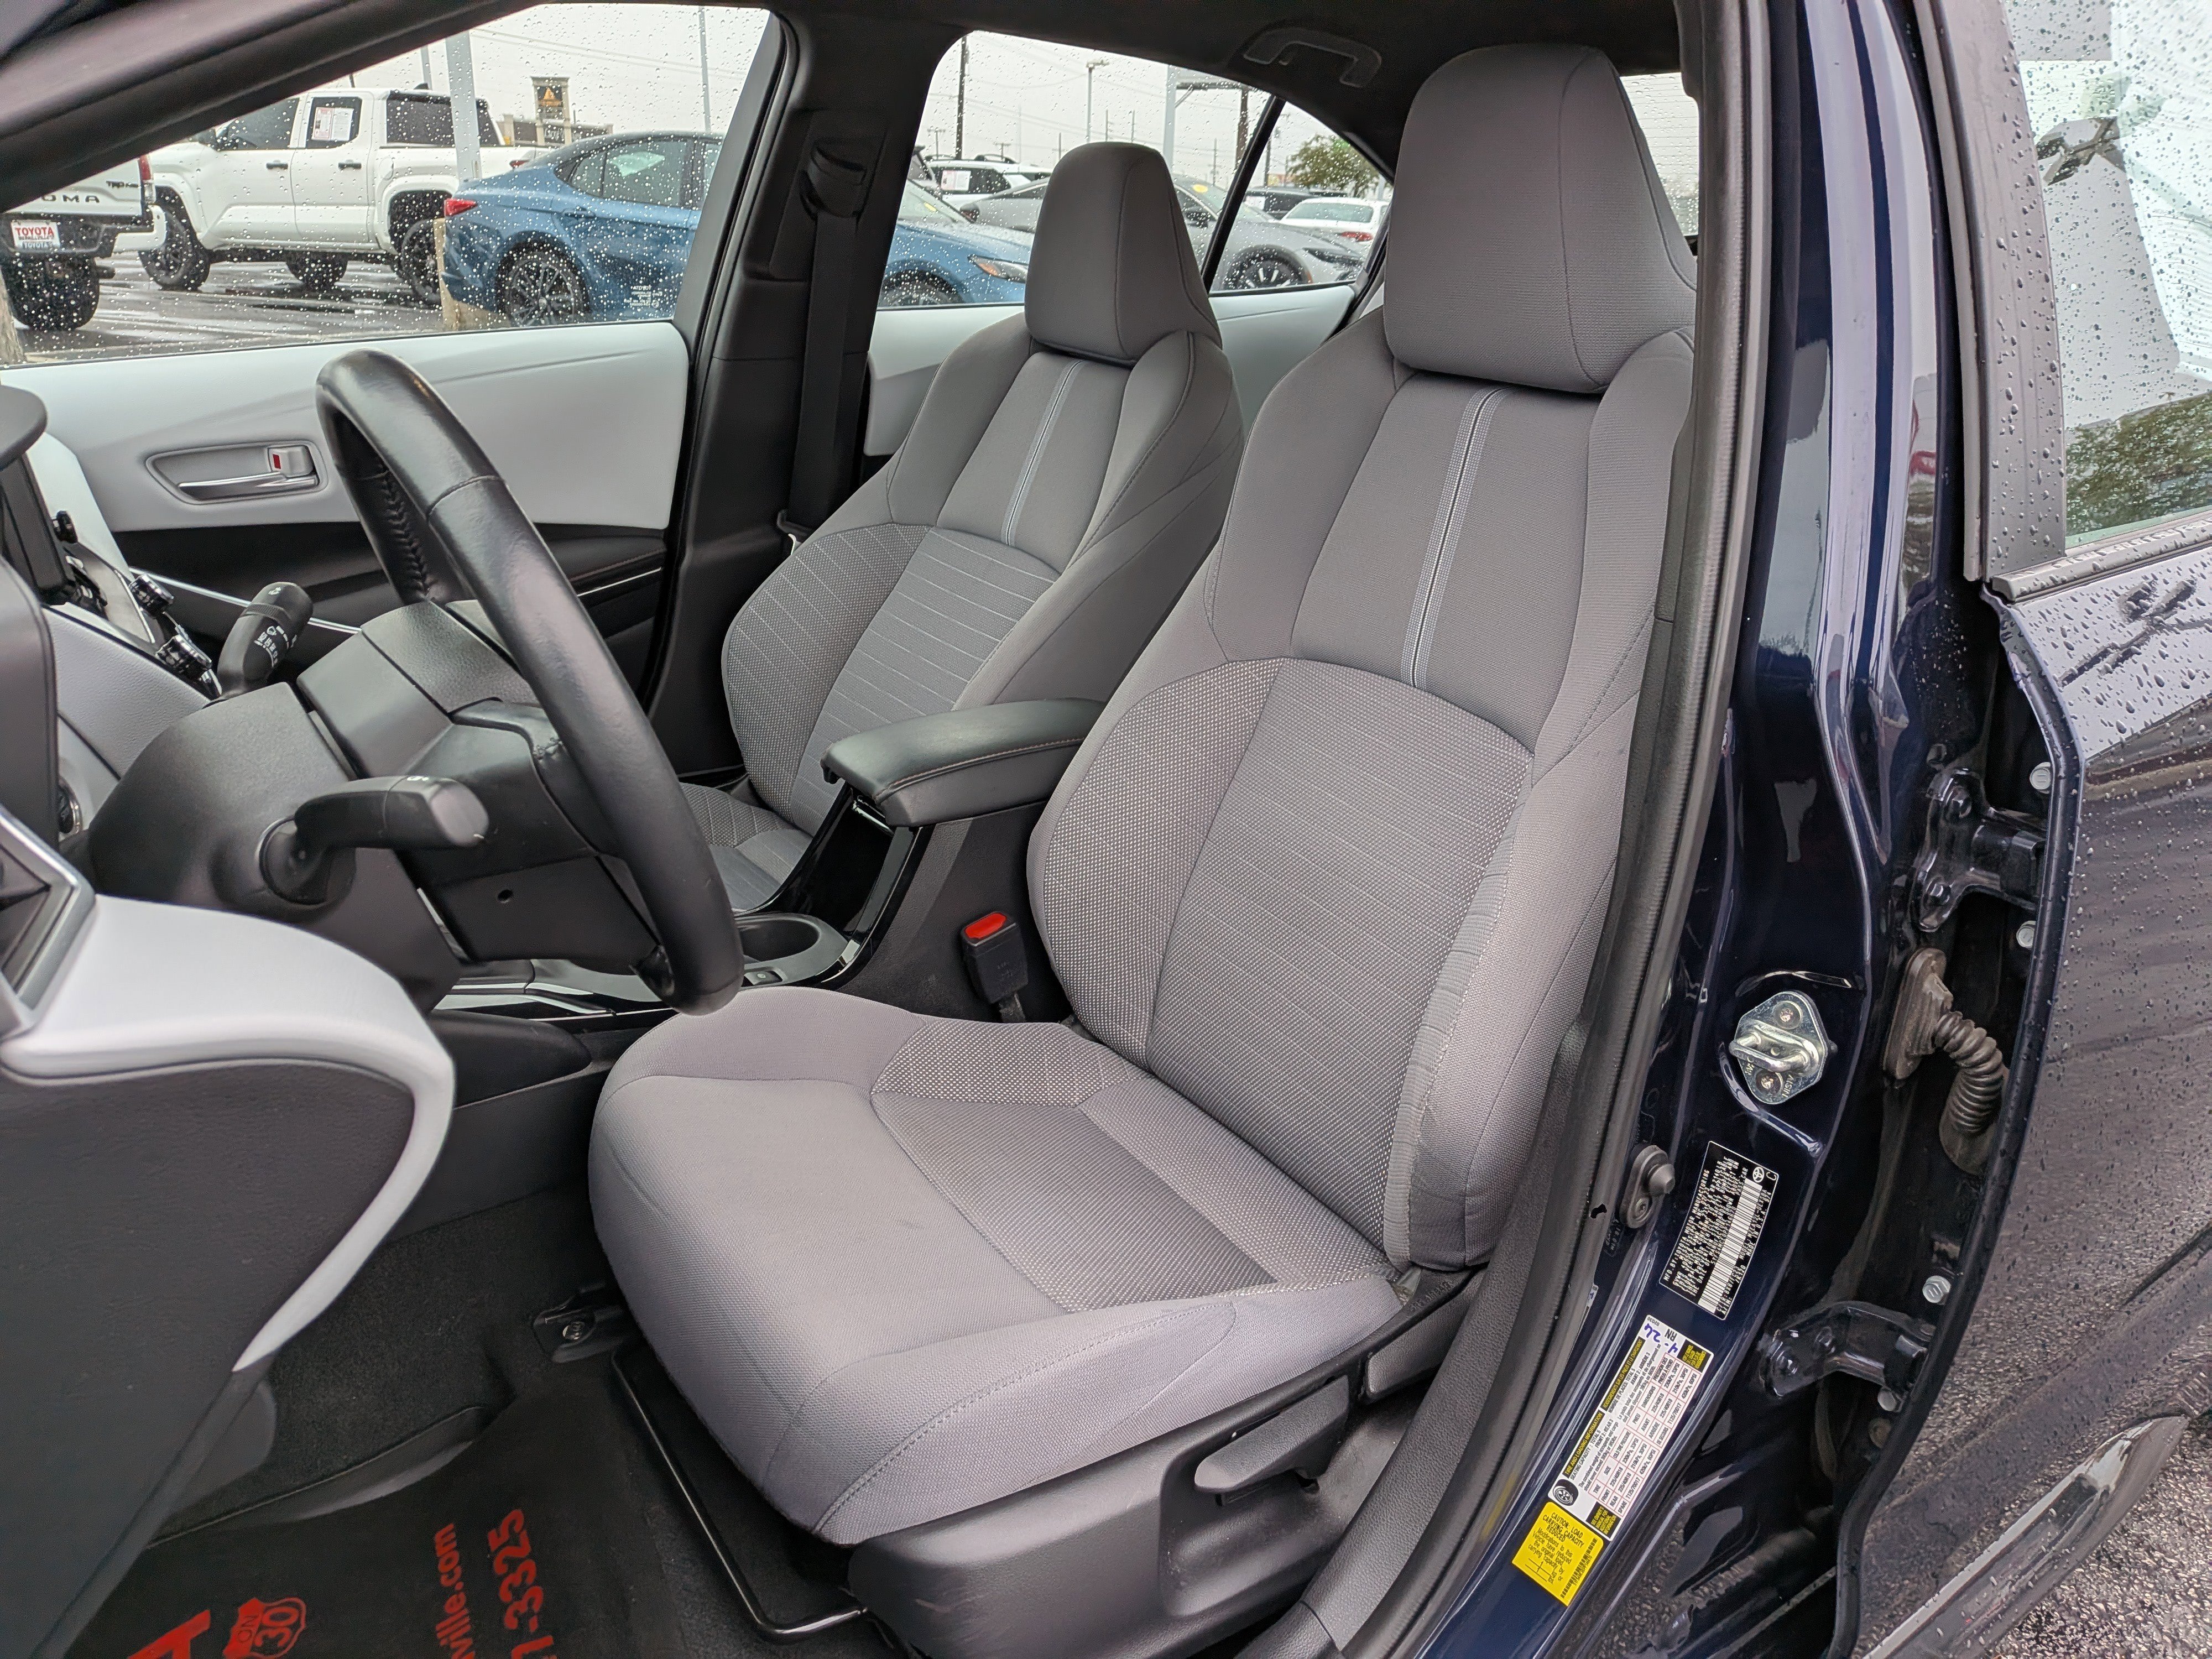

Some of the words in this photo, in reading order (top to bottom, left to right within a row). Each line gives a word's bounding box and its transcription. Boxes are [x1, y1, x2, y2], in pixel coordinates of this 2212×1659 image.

[15, 227, 54, 236] TOYOTA
[1765, 1170, 1777, 1182] C
[1683, 1215, 1695, 1235] MOTOR
[1691, 1168, 1710, 1214] MANUFACTURING
[1707, 1206, 1714, 1214] TO
[1710, 1194, 1718, 1204] ALL
[1693, 1245, 1705, 1265] MOTOR
[1702, 1219, 1715, 1244] VEHICLE
[1726, 1157, 1734, 1170] AND
[1694, 1238, 1714, 1274] PREVENTION
[1710, 1204, 1726, 1237] STANDARDS
[1732, 1160, 1739, 1170] ON
[1689, 1285, 1699, 1297] THE
[1696, 1267, 1707, 1284] DATE
[1704, 1258, 1712, 1267] OF
[1708, 1217, 1727, 1257] MANUFACTURE
[1723, 1196, 1734, 1215] SHOWN
[1745, 1240, 1756, 1257] MADE
[1751, 1230, 1759, 1239] IN
[1663, 1328, 1678, 1342] RN
[1619, 1405, 1629, 1416] poids
[1632, 1375, 1645, 1393] occupants
[1645, 1347, 1660, 1368] chargement
[1630, 1373, 1639, 1385] AVANT
[1652, 1363, 1665, 1381] PRESSION
[1657, 1371, 1667, 1384] PNEUS
[1665, 1358, 1674, 1370] FROID
[1608, 1398, 1619, 1413] NOMBRE
[1625, 1370, 1634, 1382] TOTAL
[1640, 1385, 1656, 1408] DIMENSIONS
[1650, 1392, 1665, 1413] 225/40R18
[1625, 1404, 1635, 1417] jamais
[1631, 1412, 1641, 1425] PNEU
[1659, 1397, 1673, 1418] 225/40R18
[1594, 1435, 1604, 1448] FRONT
[1603, 1421, 1612, 1432] REAR
[1640, 1417, 1651, 1432] AVANT
[1658, 1426, 1669, 1441] SECOURS
[1564, 1464, 1573, 1475] TIRE
[1569, 1455, 1578, 1467] AND
[1574, 1438, 1588, 1458] LOADING
[1584, 1412, 1603, 1440] INFORMATION
[1620, 1430, 1631, 1446] PRESSURE
[1569, 1463, 1582, 1480] SEATING
[1578, 1446, 1591, 1465] CAPACITY
[1590, 1432, 1599, 1444] TOTAL
[1581, 1464, 1594, 1482] combined
[1590, 1454, 1600, 1467] weight
[1598, 1435, 1611, 1453] occupants
[1610, 1421, 1619, 1432] cargo
[1583, 1479, 1592, 1491] should
[1594, 1459, 1603, 1472] exceed
[1603, 1465, 1611, 1475] SIZE
[1609, 1465, 1624, 1487] 225/40R18
[1593, 1483, 1601, 1494] TIRE
[1617, 1472, 1632, 1493] 225/40R18
[1600, 1488, 1611, 1502] FRONT
[1609, 1495, 1619, 1507] REAR
[1617, 1500, 1627, 1514] SPARE
[1541, 1514, 1564, 1533] CARRYING
[1562, 1529, 1585, 1549] CAPACITY
[1545, 1524, 1566, 1543] REDUCED
[1550, 1511, 1571, 1530] CAUTION:
[1570, 1526, 1584, 1539] LOAD
[1531, 1530, 1546, 1545] Vehicle
[1545, 1541, 1557, 1552] have
[1556, 1550, 1572, 1564] reduced
[1536, 1527, 1560, 1548] Modifications
[1564, 1548, 1573, 1558] this
[1526, 1543, 1543, 1558] carrying
[1541, 1554, 1558, 1571] capacity
[1558, 1566, 1565, 1575] by
[1540, 1546, 1554, 1560] original
[1554, 1556, 1564, 1566] load
[488, 1510, 557, 1659] 1-3325
[1550, 1568, 1558, 1579] kg
[435, 1524, 474, 1659] ville.com
[238, 1614, 258, 1643] ON
[255, 1606, 299, 1646] 30
